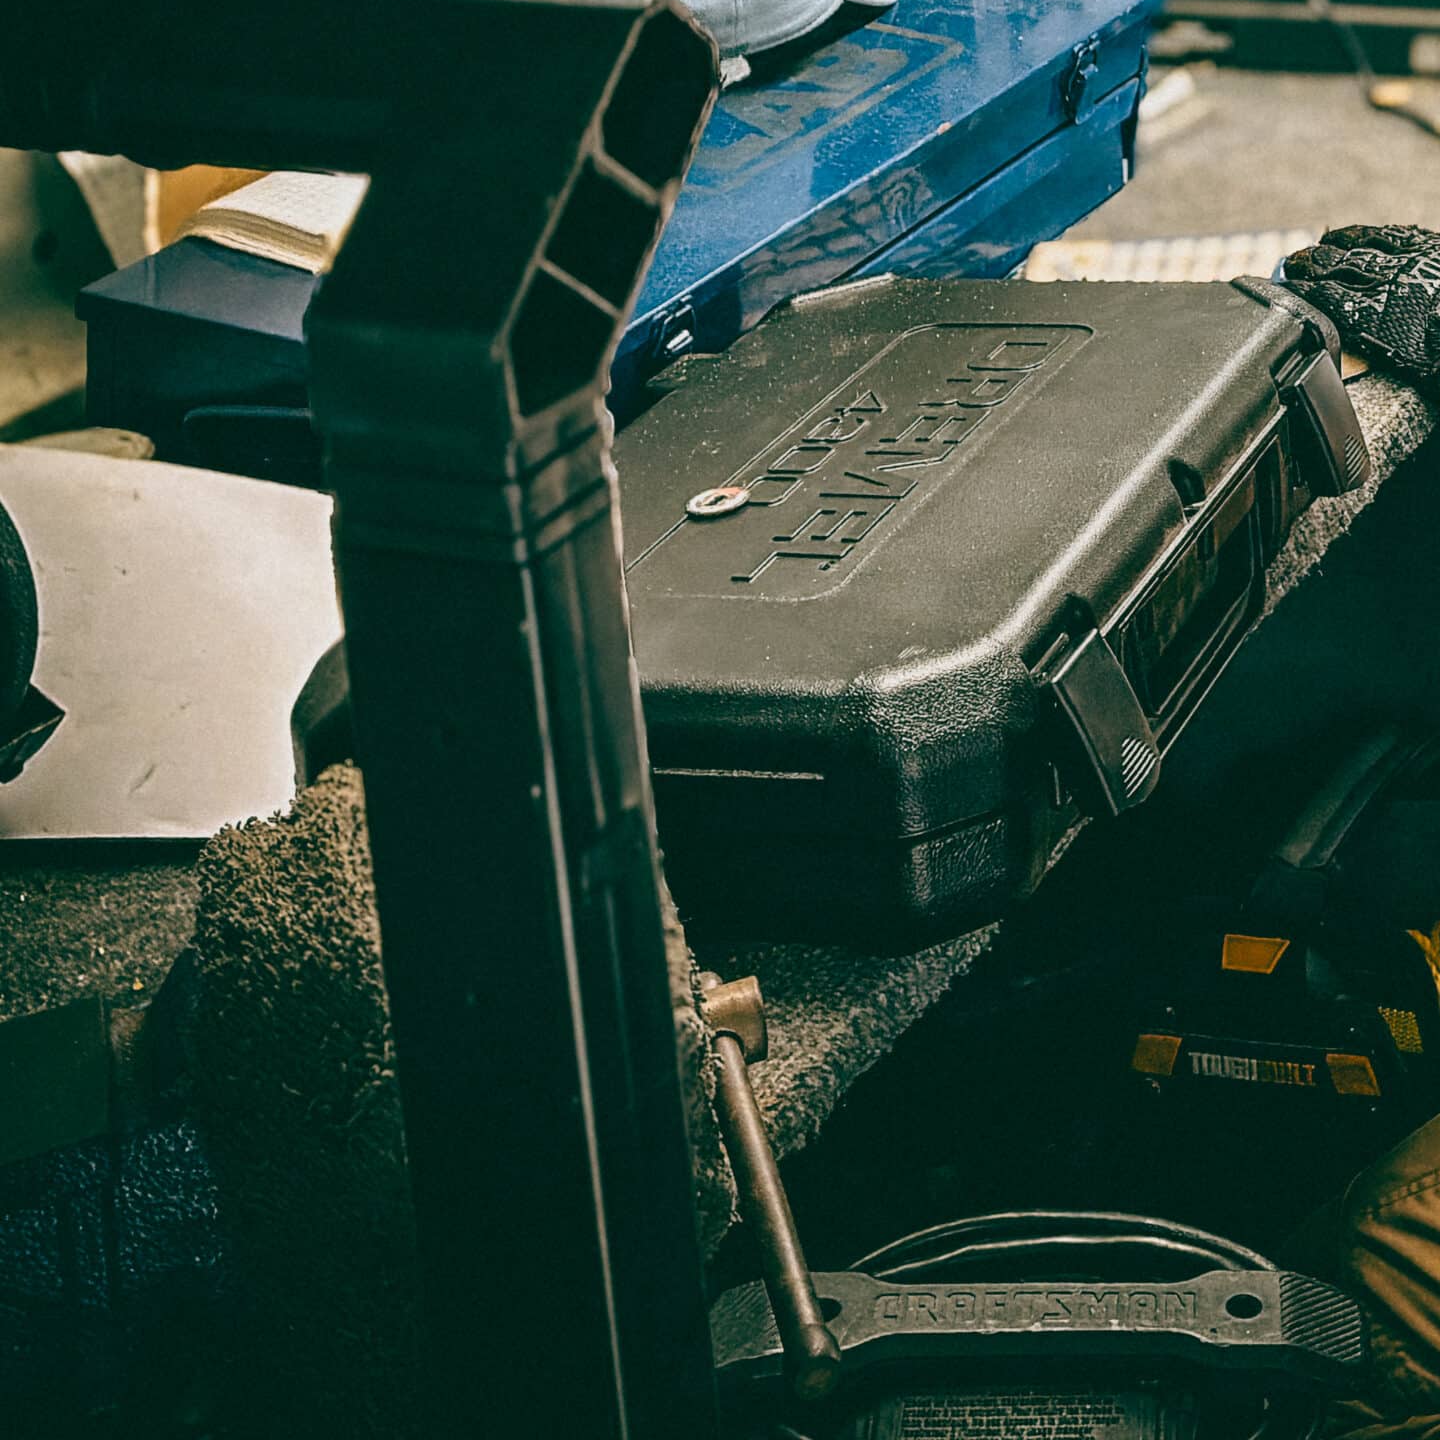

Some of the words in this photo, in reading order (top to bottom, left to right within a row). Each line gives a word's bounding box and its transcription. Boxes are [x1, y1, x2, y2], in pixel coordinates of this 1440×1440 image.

[731, 335, 1069, 583] DREMEL
[1188, 1051, 1316, 1086] TOUGHBUILT
[873, 1290, 1200, 1324] CRAFTSMAN
